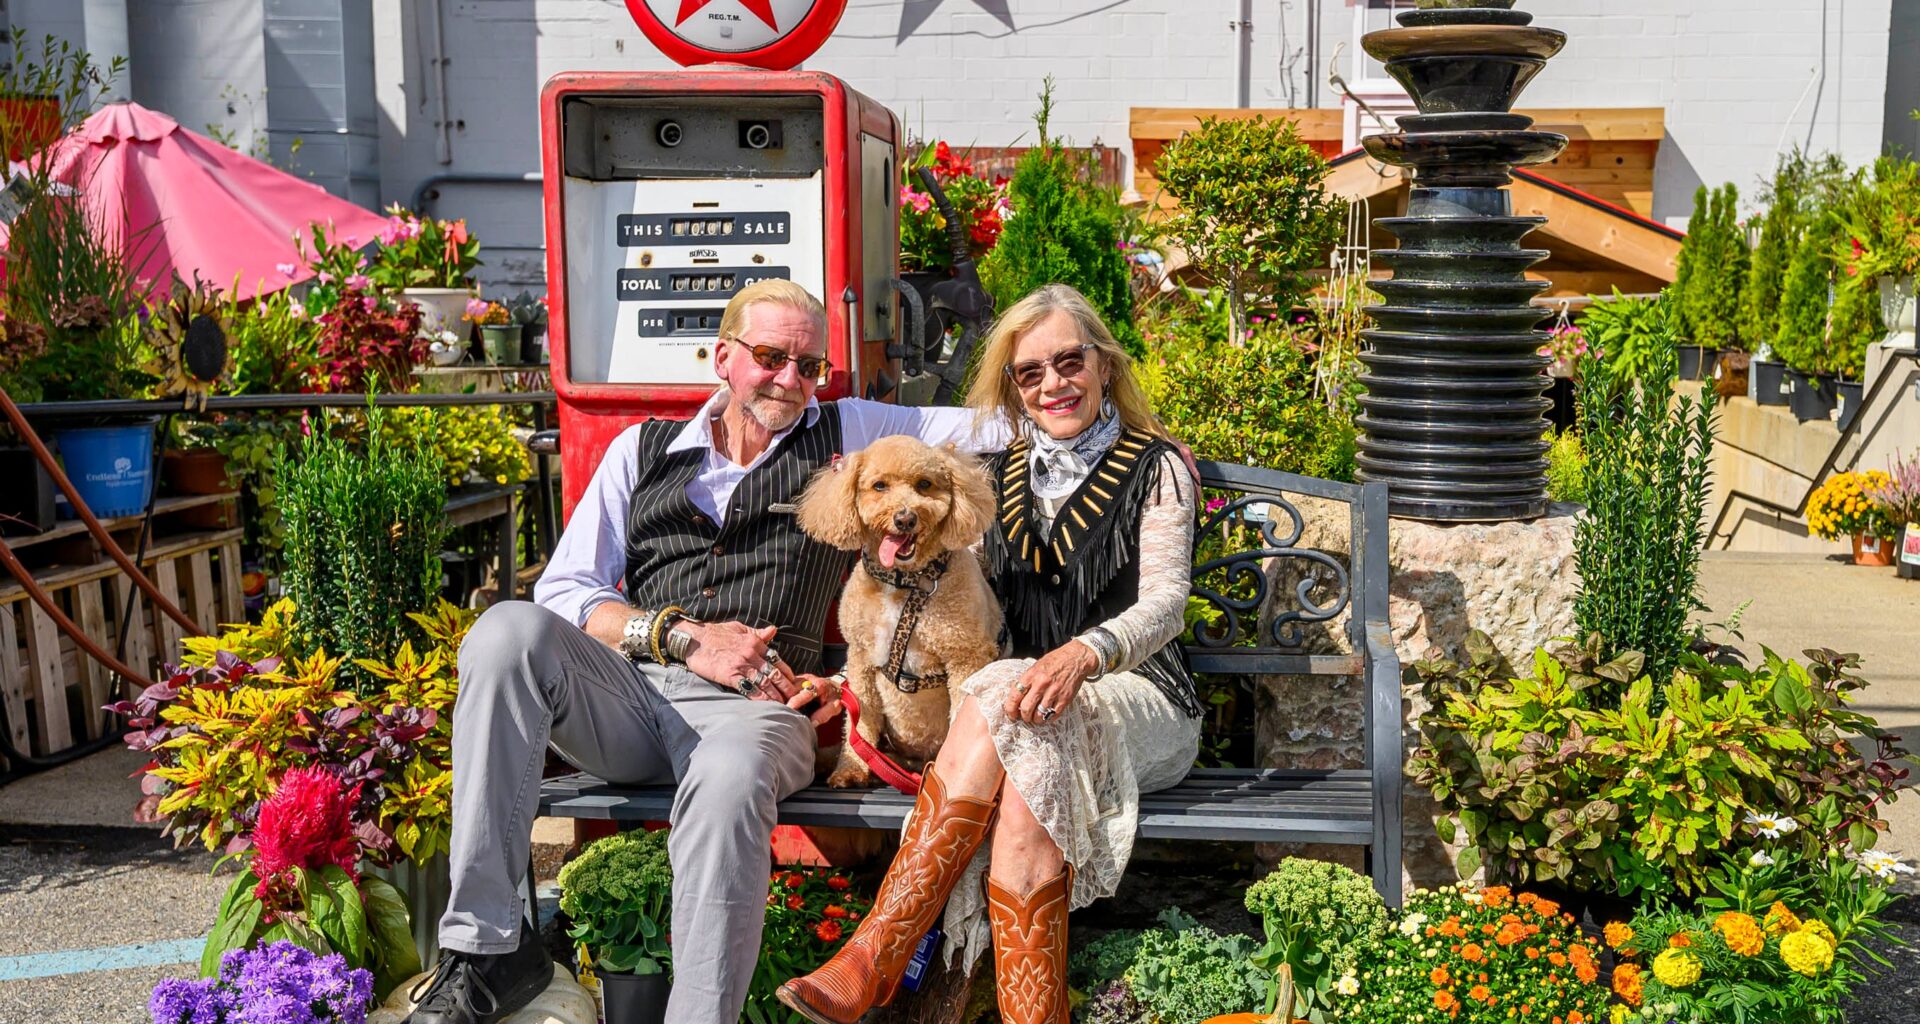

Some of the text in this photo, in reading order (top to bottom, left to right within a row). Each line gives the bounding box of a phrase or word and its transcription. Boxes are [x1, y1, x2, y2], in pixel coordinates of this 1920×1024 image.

[623, 224, 663, 236] THIS
[743, 222, 785, 234] SALE
[689, 249, 718, 258] BOWSER
[621, 278, 662, 291] TOTAL
[642, 319, 664, 327] PER
